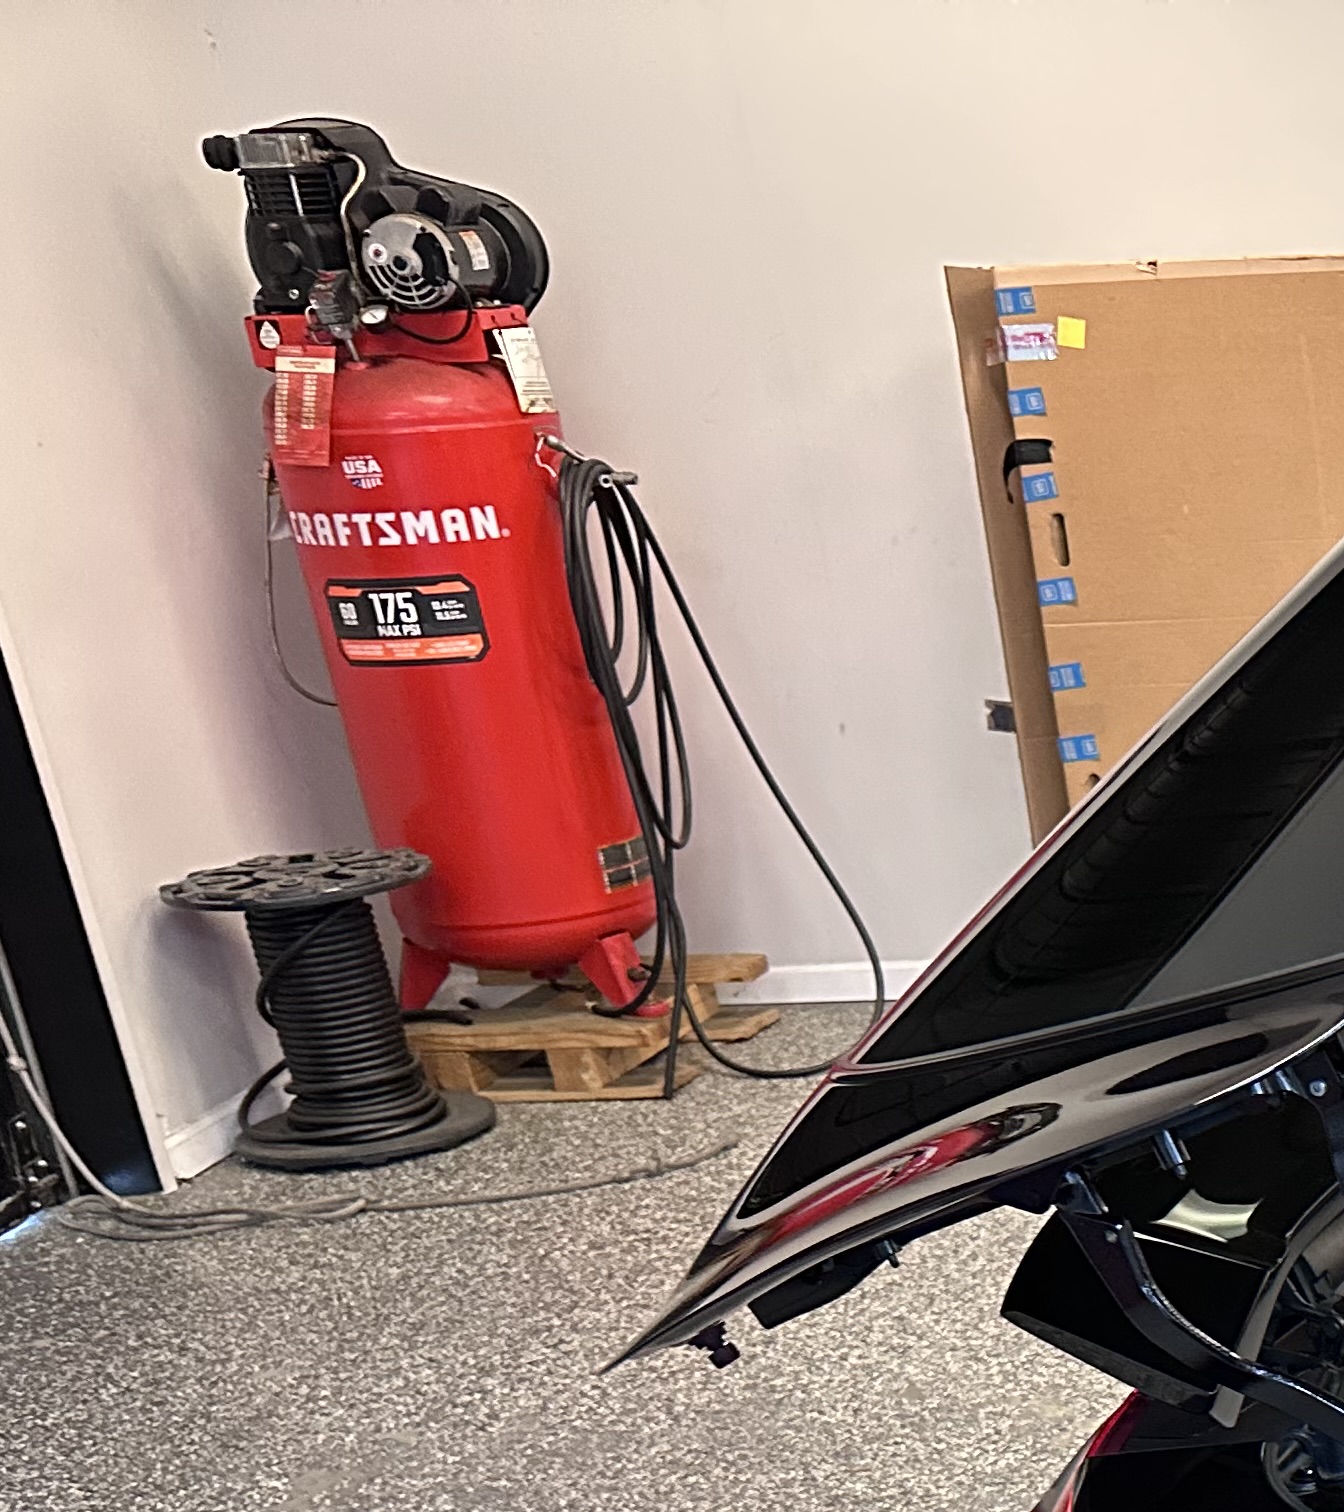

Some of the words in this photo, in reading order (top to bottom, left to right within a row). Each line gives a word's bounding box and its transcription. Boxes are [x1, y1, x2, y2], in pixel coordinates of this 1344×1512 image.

[341, 460, 382, 474] USA
[289, 505, 502, 546] CRAFTSMAN
[368, 591, 418, 624] 175
